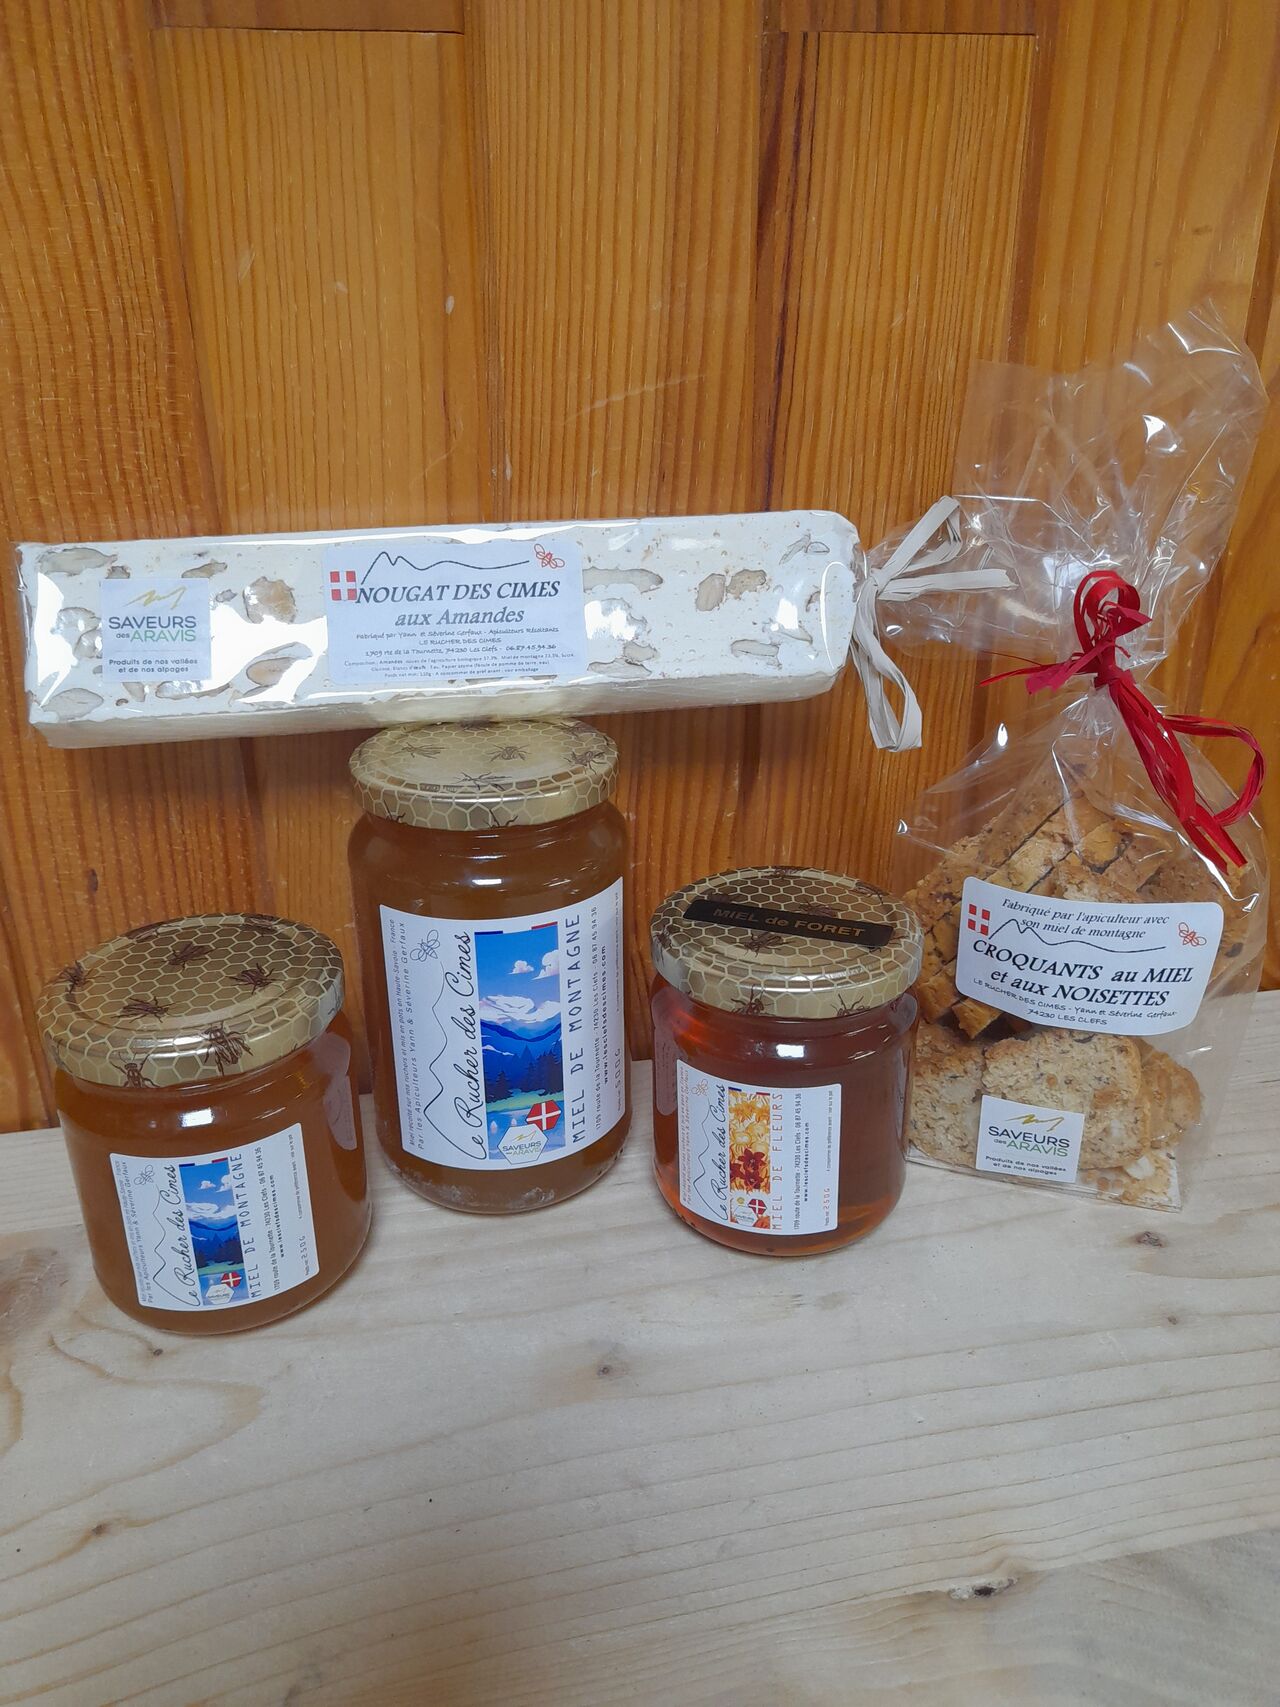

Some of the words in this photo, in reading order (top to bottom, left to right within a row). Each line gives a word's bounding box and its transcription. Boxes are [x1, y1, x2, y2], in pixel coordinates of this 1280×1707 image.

[356, 584, 449, 604] NOUGAT
[452, 583, 492, 601] DES
[496, 580, 560, 598] CIMES
[109, 616, 196, 629] SAVEURS
[395, 612, 432, 626] aux
[436, 606, 525, 625] Amandes
[130, 630, 196, 642] ARAVIS
[157, 666, 189, 674] alpages
[591, 906, 597, 916] 36
[713, 908, 758, 922] MIEL
[765, 916, 790, 927] de
[794, 920, 865, 937] FORET
[1002, 898, 1051, 917] Fabriqué
[1052, 910, 1074, 920] par
[1076, 912, 1142, 924] l'apiculteur
[1143, 916, 1170, 924] avec
[591, 919, 597, 928] 94
[1020, 919, 1040, 928] son
[1043, 923, 1069, 934] miel
[1071, 926, 1086, 936] de
[1088, 929, 1146, 940] montagne
[399, 922, 408, 964] Gerfaux
[591, 930, 598, 941] 45
[592, 944, 598, 952] 87
[592, 954, 598, 964] 06
[392, 950, 401, 996] Haute-Savoie
[445, 931, 474, 997] Cimes
[973, 940, 1103, 980] CROQUANTS
[1111, 970, 1138, 982] au
[1141, 967, 1194, 983] MIEL
[565, 915, 582, 1032] MONTAGNE
[404, 968, 413, 1013] Séverine
[990, 970, 1008, 983] et
[1011, 978, 1050, 996] aux
[1052, 985, 1170, 1006] NOISETTES
[397, 998, 402, 1007] en
[985, 983, 1017, 1000] RUCHER
[1018, 995, 1036, 1005] DES
[1037, 1001, 1066, 1011] CIMES
[1074, 1007, 1097, 1015] Yann
[1108, 1010, 1142, 1018] Séverine
[1147, 1011, 1178, 1020] Gerfaux
[451, 1004, 476, 1040] des
[1026, 1009, 1055, 1019] 74230
[1058, 1014, 1076, 1022] LES
[1078, 1017, 1108, 1025] CLEFS
[399, 1025, 405, 1034] en
[570, 1048, 584, 1075] DE
[410, 1057, 421, 1113] Apiculteurs
[453, 1047, 484, 1127] Rucher
[595, 1083, 601, 1091] de
[710, 1085, 726, 1122] Cimes
[572, 1089, 586, 1143] MIEL
[772, 1093, 782, 1151] FLEURS
[502, 1140, 542, 1151] SAVEURS
[712, 1127, 725, 1148] des
[988, 1126, 1070, 1148] SAVEURS
[1007, 1140, 1068, 1157] ARAVIS
[772, 1166, 782, 1181] DE
[985, 1156, 1013, 1164] Produits
[1042, 1164, 1066, 1172] vallées
[1028, 1167, 1057, 1175] alpages
[160, 1165, 181, 1205] Cimes
[711, 1152, 728, 1200] Rucher
[230, 1154, 251, 1227] MONTAGNE
[166, 1209, 185, 1231] des
[264, 1211, 272, 1226] 74230
[270, 1175, 284, 1257] www.lesclefsdescimes.com
[772, 1196, 782, 1230] MIEL
[243, 1237, 255, 1254] DE
[299, 1236, 308, 1259] 250G
[171, 1235, 195, 1286] Rucher
[248, 1264, 261, 1298] MIEL
